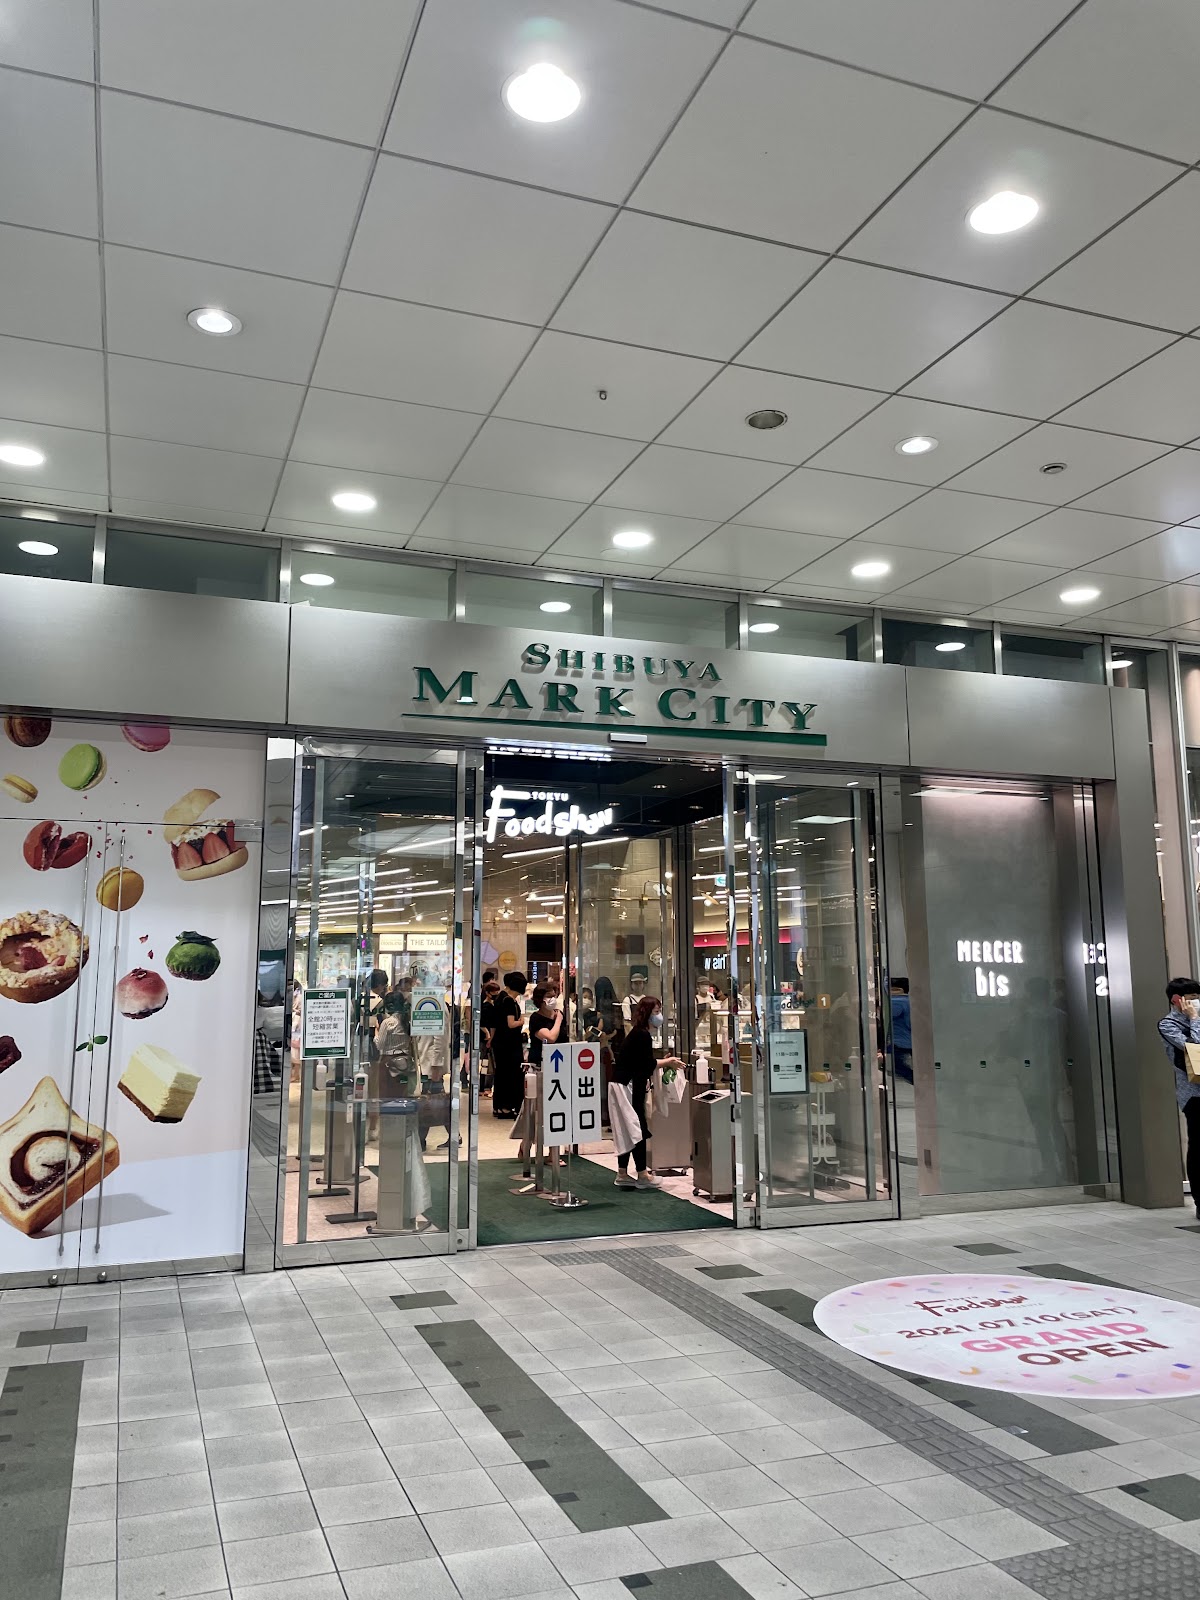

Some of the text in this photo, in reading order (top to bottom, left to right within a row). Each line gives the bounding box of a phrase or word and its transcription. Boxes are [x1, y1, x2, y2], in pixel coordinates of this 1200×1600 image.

[522, 643, 722, 682] SHIBUYA
[413, 666, 818, 730] MARK CITY
[531, 791, 569, 802] TOKYU
[485, 784, 613, 843] Foodshow
[956, 940, 1024, 964] MERCER
[975, 966, 1010, 997] bis
[820, 996, 827, 1007] 1
[547, 1078, 567, 1132] 入口
[577, 1076, 595, 1130] 出口
[961, 1322, 1149, 1352] GRAND
[1017, 1338, 1172, 1365] OPEN
